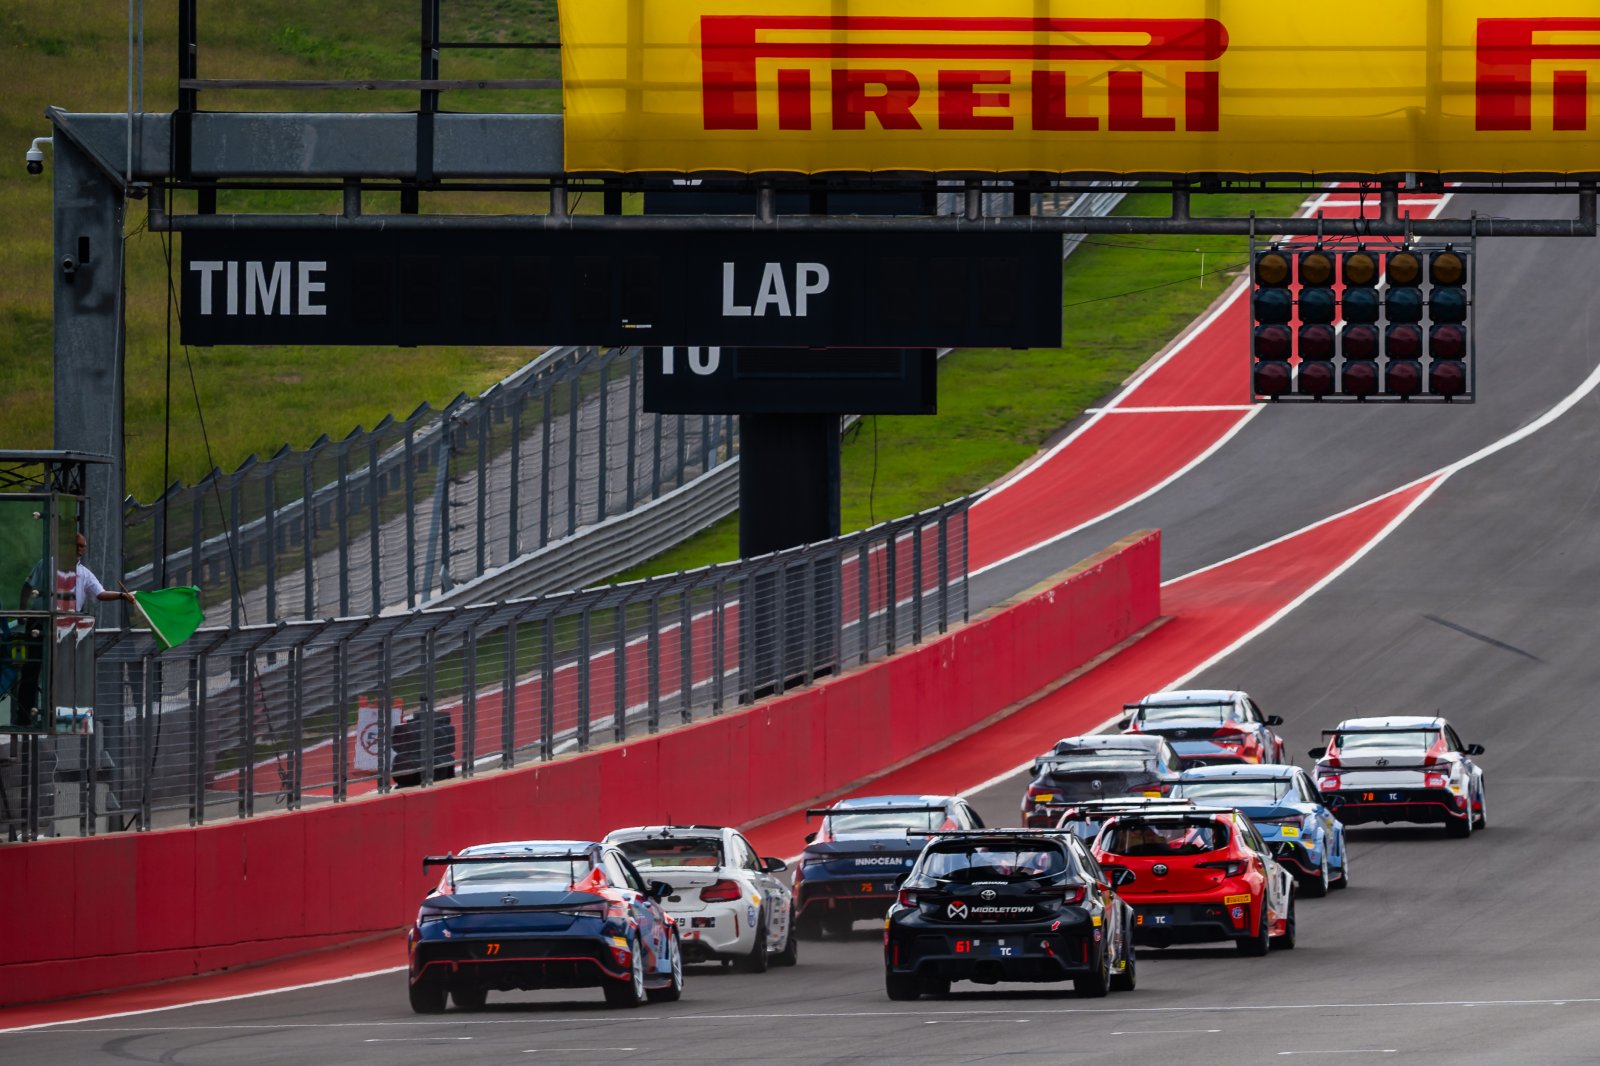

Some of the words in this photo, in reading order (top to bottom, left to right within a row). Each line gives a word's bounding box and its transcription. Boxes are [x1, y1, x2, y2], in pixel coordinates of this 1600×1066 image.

[700, 15, 1229, 131] PIRELLI
[189, 260, 328, 316] TIME
[721, 262, 830, 317] LAP
[1388, 793, 1398, 801] TC
[855, 857, 903, 866] INNOCEAN
[861, 883, 873, 892] 75
[884, 883, 895, 891] TC
[1155, 916, 1166, 924] TC
[487, 943, 500, 955] 77
[956, 941, 971, 953] 61
[1000, 947, 1012, 956] TC
